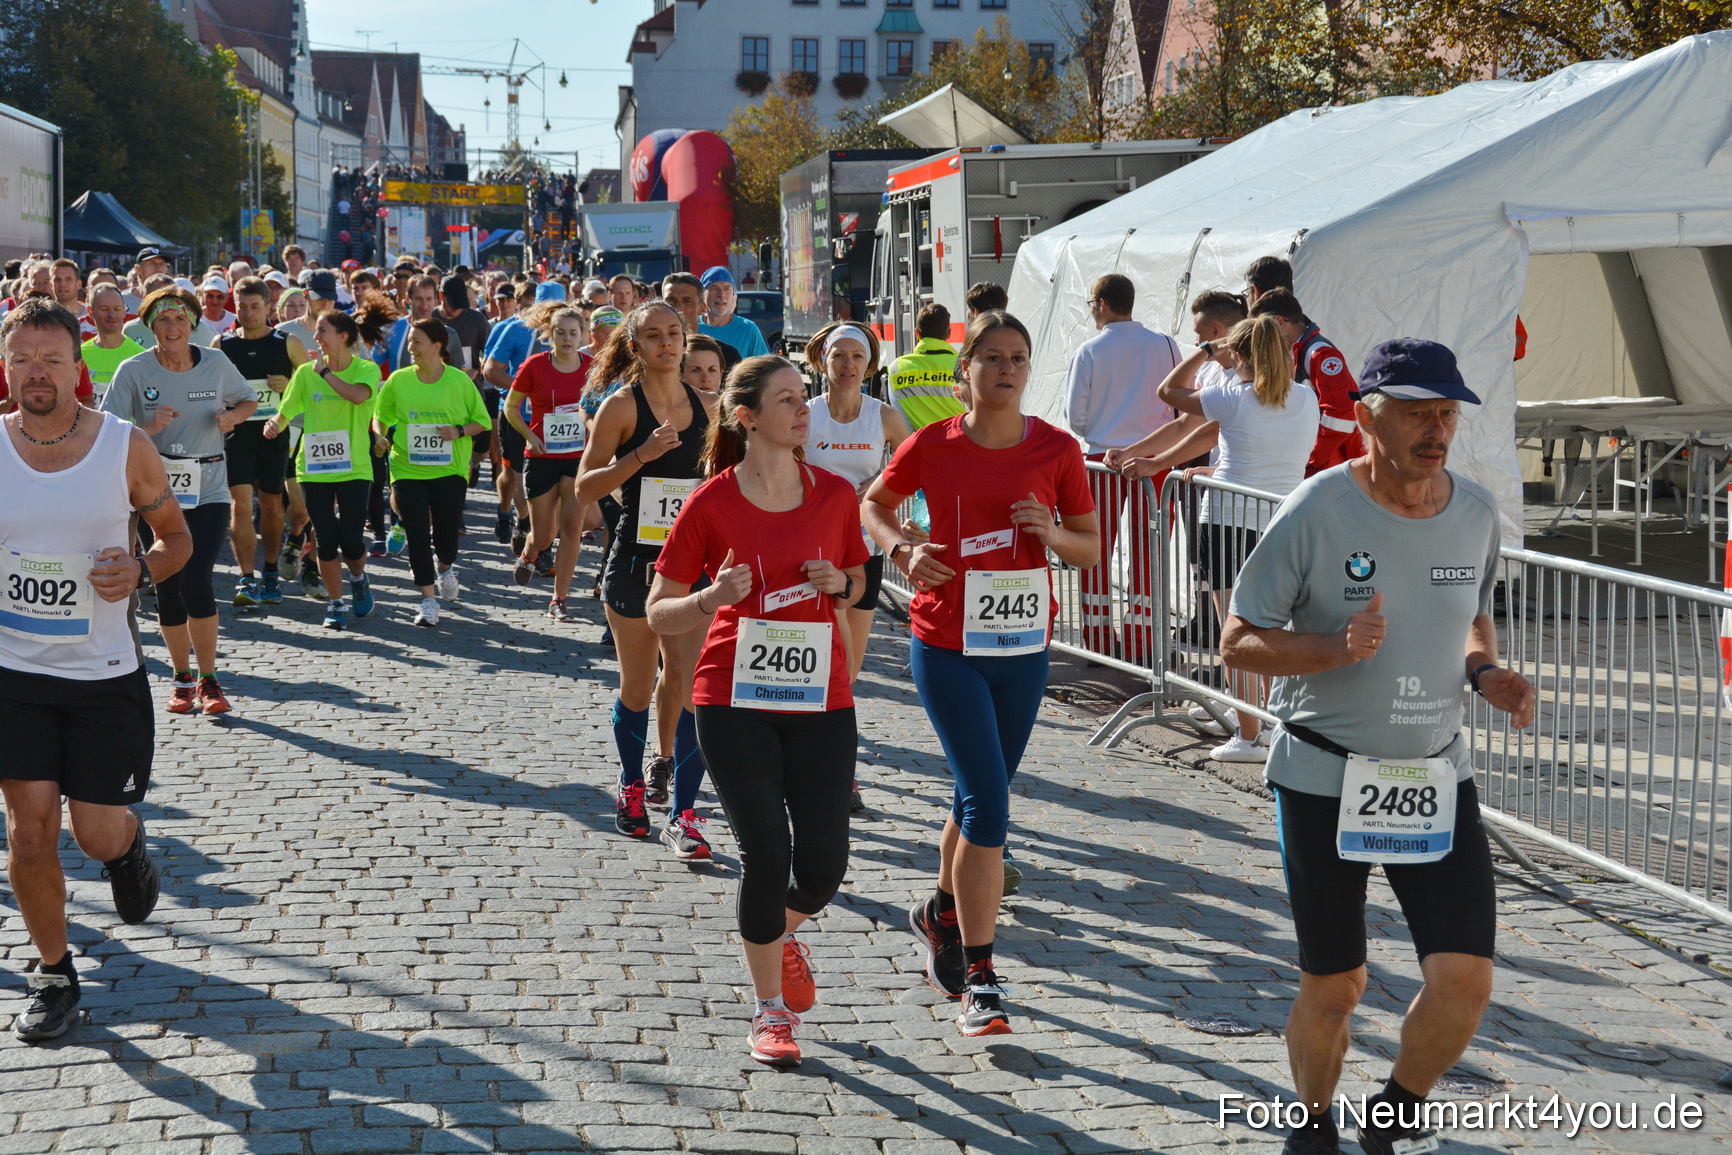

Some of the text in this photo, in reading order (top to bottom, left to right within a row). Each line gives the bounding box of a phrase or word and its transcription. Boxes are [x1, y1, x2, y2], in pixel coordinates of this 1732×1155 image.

[20, 166, 53, 225] BOCK
[431, 187, 480, 199] START
[609, 226, 652, 234] BOCK
[897, 372, 955, 385] Org.-Leite
[188, 390, 217, 399] BOCK
[550, 423, 580, 436] 2472
[170, 443, 186, 453] 19.
[414, 435, 445, 448] 2167
[311, 442, 344, 457] 2168
[167, 473, 191, 487] 73
[663, 485, 691, 493] BOCK
[658, 497, 687, 518] 13
[975, 536, 998, 549] DEHN
[21, 559, 63, 572] BOCK
[1431, 566, 1476, 581] BOCK
[993, 577, 1029, 587] BOCK
[8, 574, 77, 606] 3092
[779, 589, 803, 602] DEHN
[13, 604, 62, 616] PARTL Neumarkt
[979, 593, 1039, 620] 2443
[766, 628, 806, 639] BOCK
[997, 635, 1020, 646] Nina
[749, 644, 817, 674] 2460
[754, 674, 774, 682] PARTL
[755, 686, 805, 700] Christina
[1396, 676, 1427, 697] 19.
[1389, 711, 1444, 724] Stadtlauf
[1379, 765, 1428, 779] BOCK
[1358, 784, 1438, 817] 2488
[1363, 835, 1429, 853] Wolfgang
